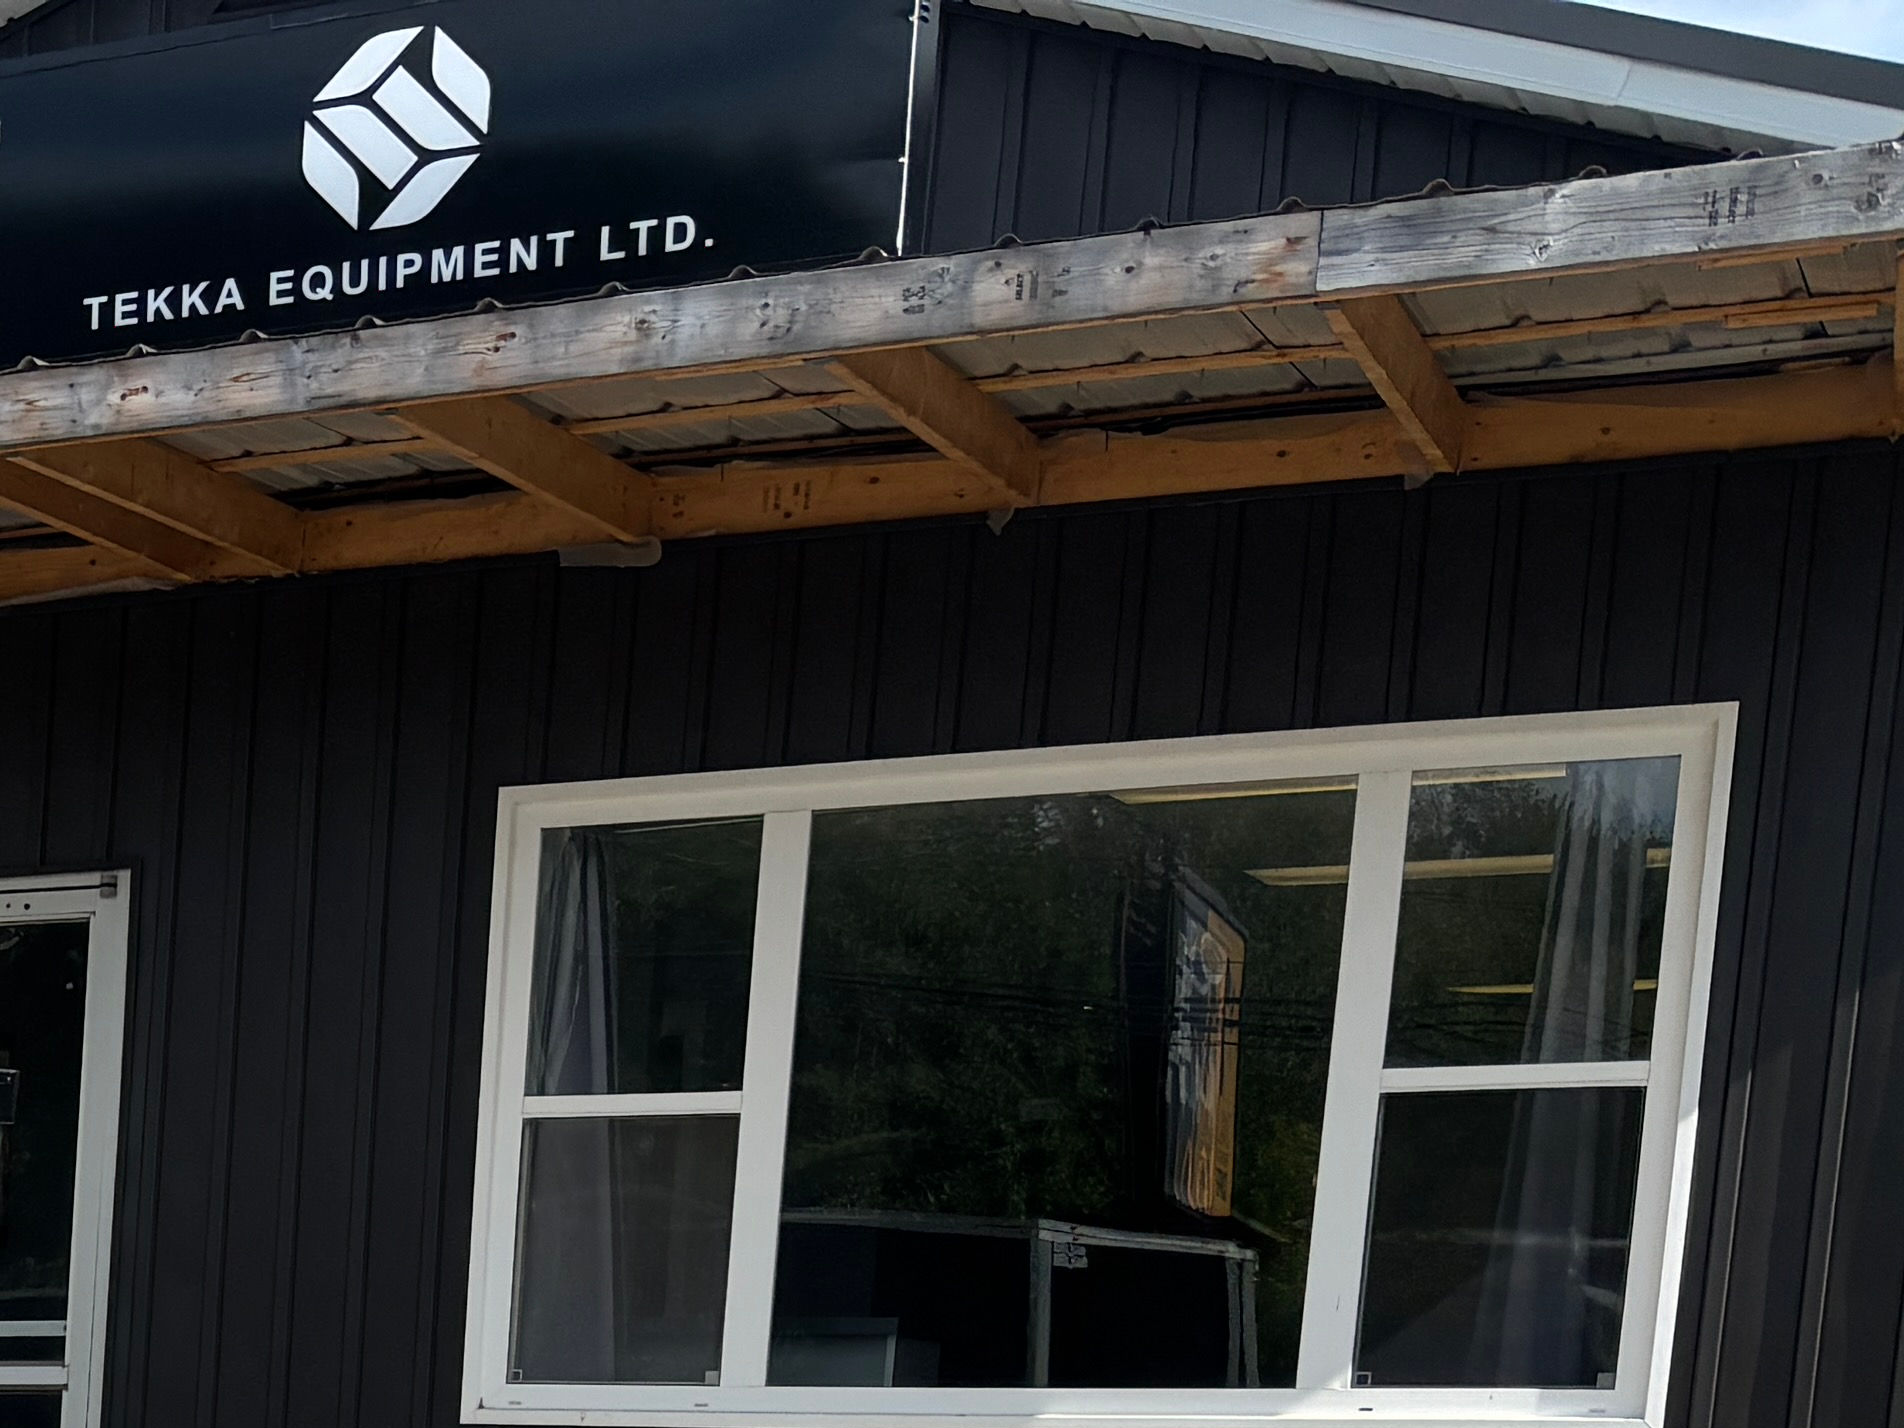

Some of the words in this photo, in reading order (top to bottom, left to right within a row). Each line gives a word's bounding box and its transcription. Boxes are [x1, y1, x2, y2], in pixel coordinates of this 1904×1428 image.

[82, 277, 245, 330] TEKKA
[268, 230, 575, 306] EQUIPMENT
[599, 214, 715, 261] LTD.
